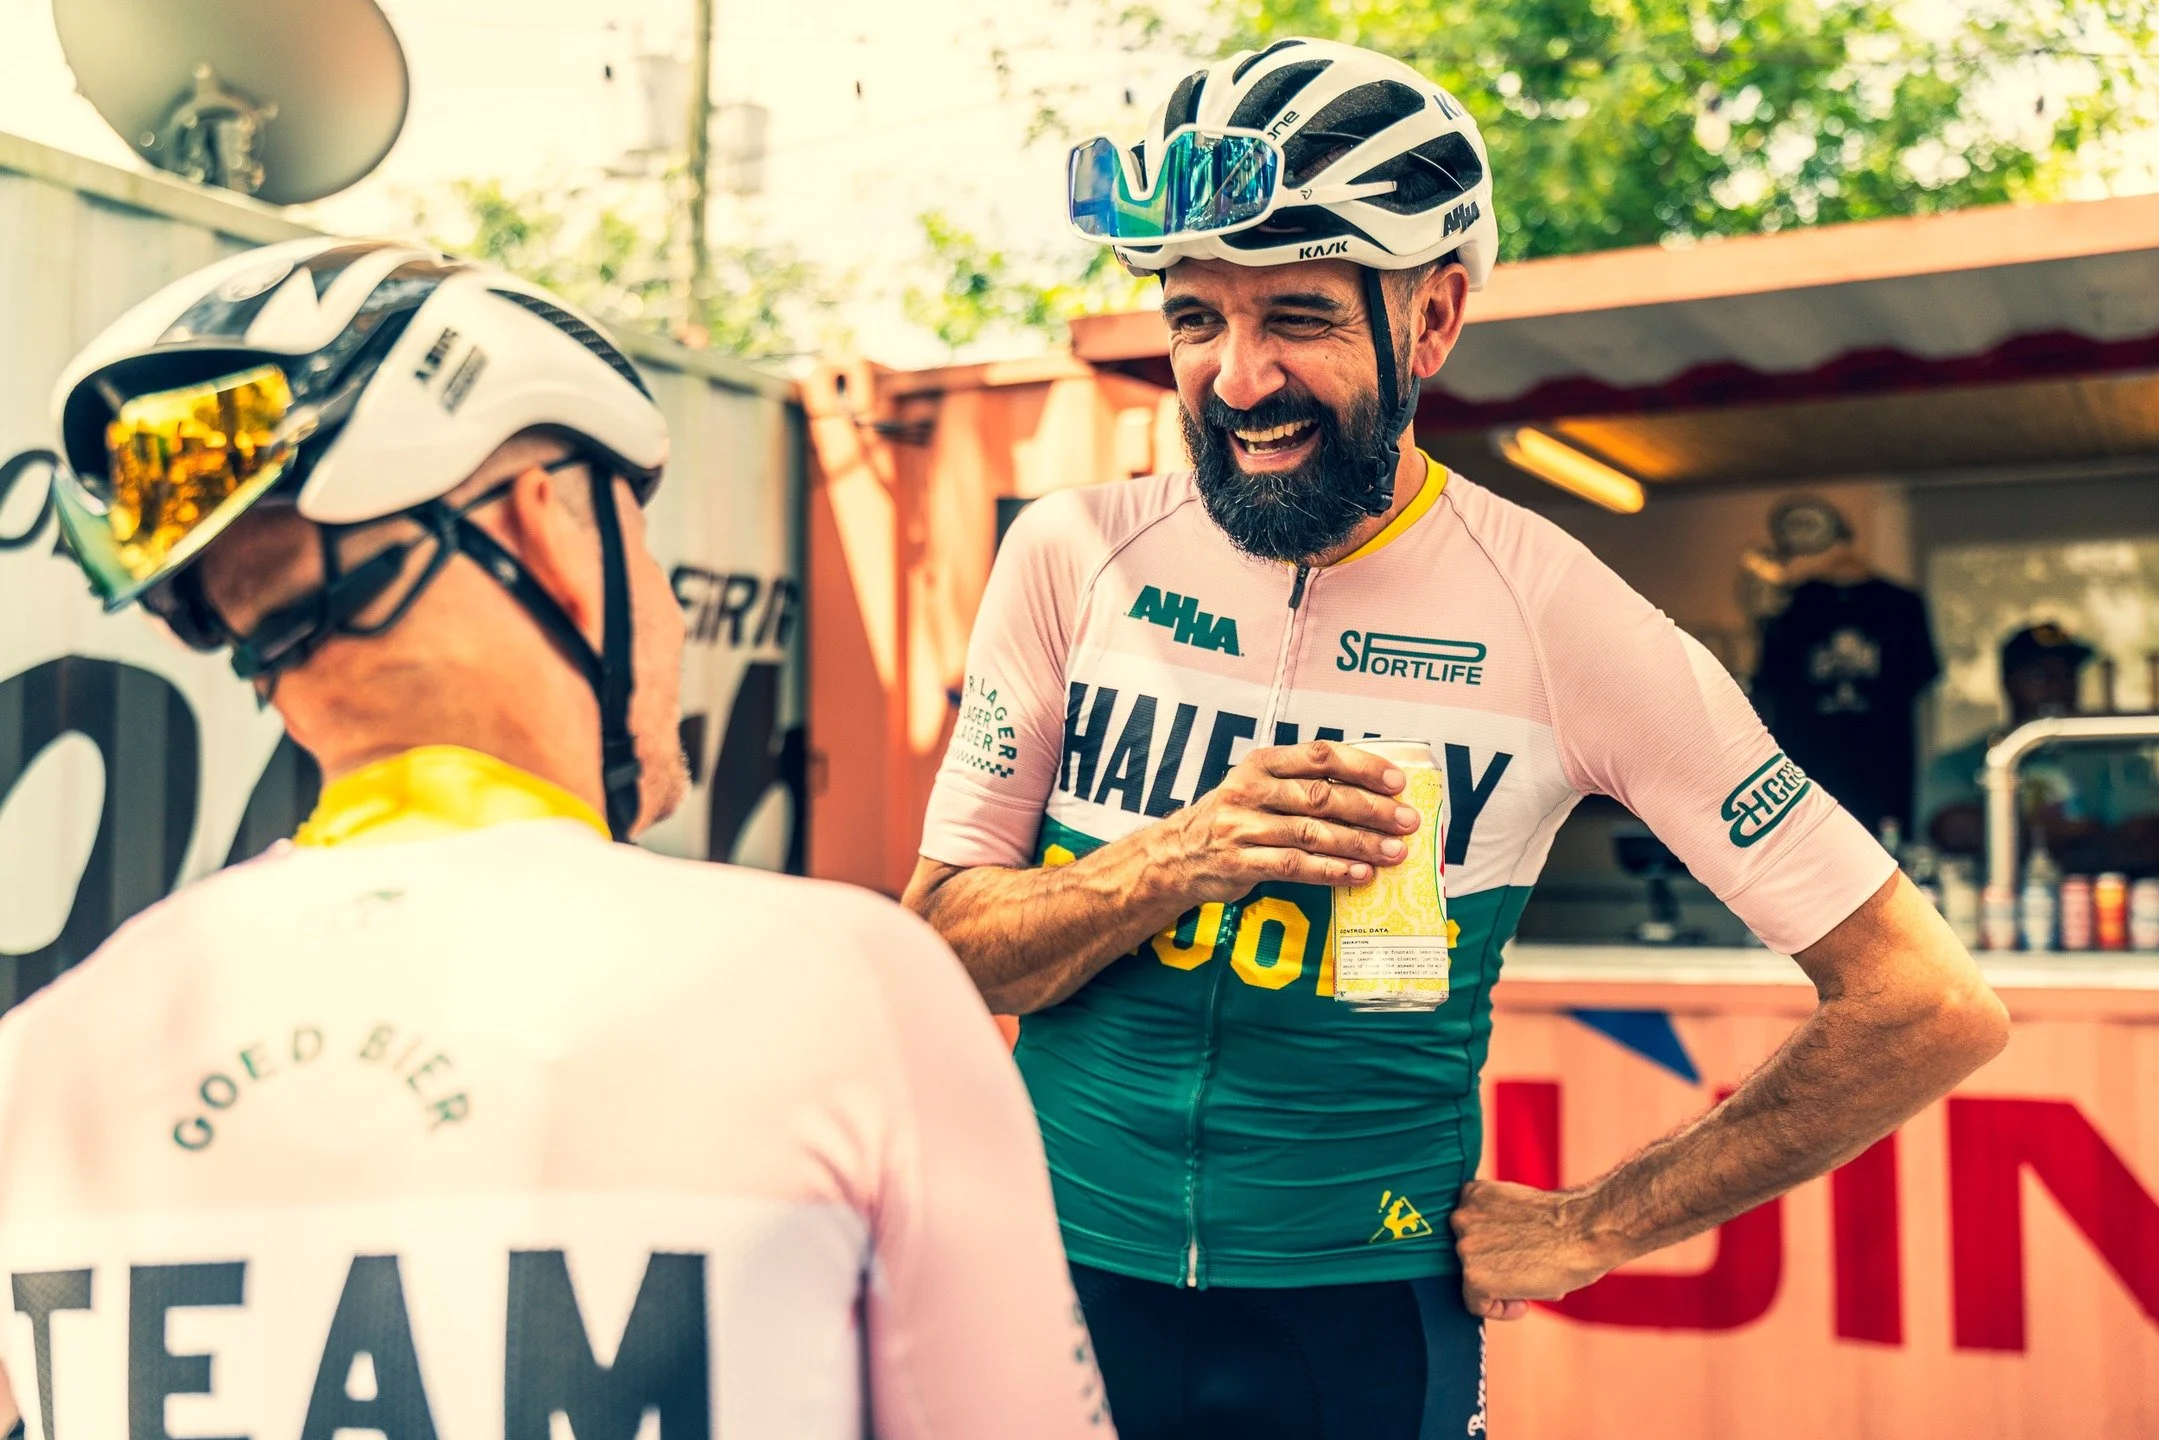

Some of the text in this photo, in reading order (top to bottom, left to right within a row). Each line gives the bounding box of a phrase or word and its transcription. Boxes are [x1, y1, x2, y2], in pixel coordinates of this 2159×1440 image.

[1299, 241, 1348, 259] KASK
[1336, 630, 1487, 685] SPORTLIFE
[980, 678, 1017, 760] LAGER
[1059, 681, 1513, 866] HALFY
[173, 1025, 469, 1151] GOED BIER
[12, 1250, 709, 1440] TEAM
